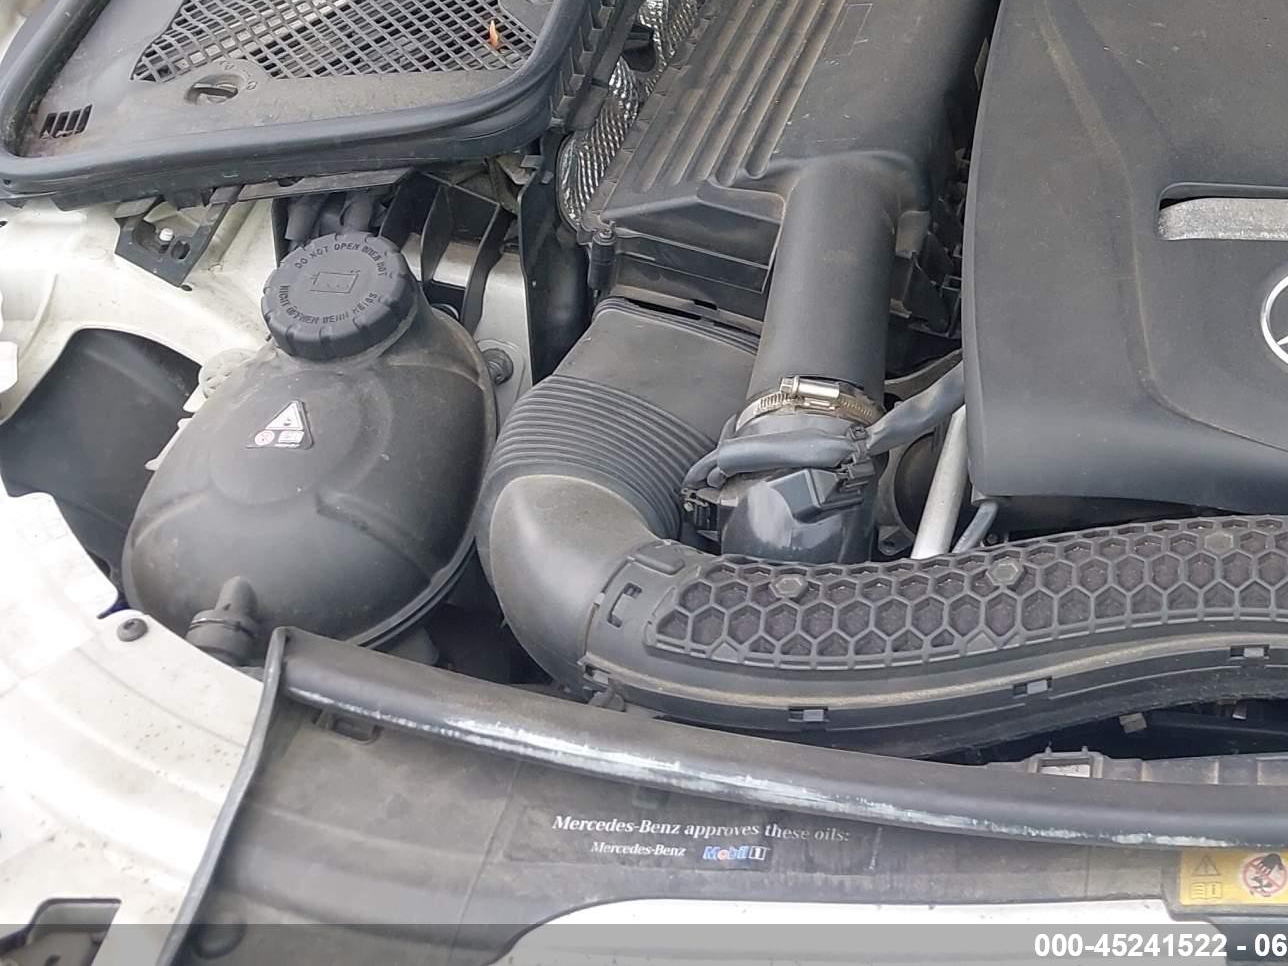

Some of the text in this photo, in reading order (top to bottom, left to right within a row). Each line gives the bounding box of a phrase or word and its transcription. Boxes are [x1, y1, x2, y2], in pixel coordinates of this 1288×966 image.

[294, 257, 309, 270] DO
[308, 245, 330, 260] NOT
[334, 242, 361, 251] OPEN
[552, 815, 851, 842] Mercedes-Benz approves these oils:
[590, 841, 687, 856] Mercedes-Benz
[702, 845, 749, 860] Mobil
